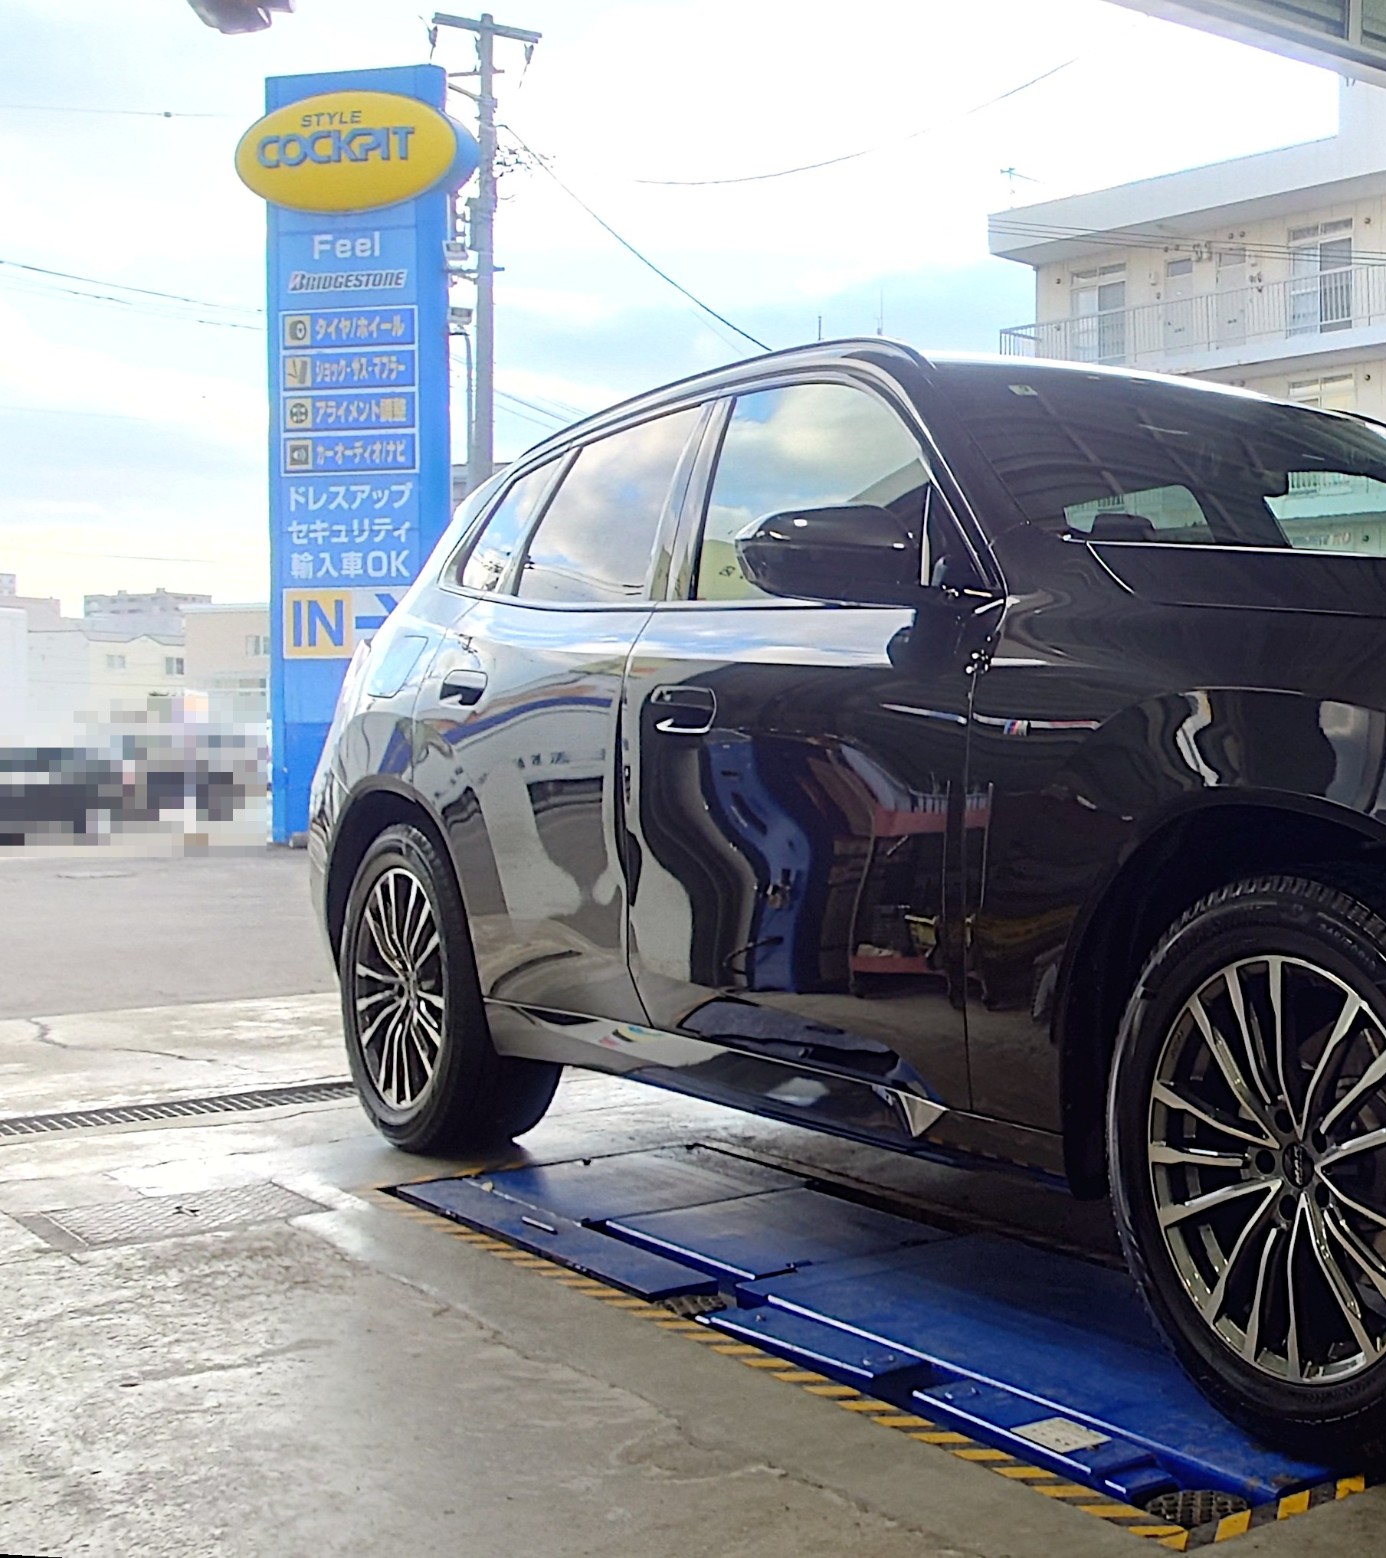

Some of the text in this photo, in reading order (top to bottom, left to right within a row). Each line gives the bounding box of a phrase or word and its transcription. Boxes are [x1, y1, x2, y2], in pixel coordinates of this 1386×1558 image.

[301, 110, 362, 127] STYLE
[257, 126, 415, 169] COCKPIT
[313, 231, 380, 260] Feel
[290, 271, 405, 292] BRIDGESTONE
[289, 481, 413, 512] ドレスアップ
[288, 518, 412, 545] セキュリティ
[290, 549, 411, 580] 輸入車OK
[293, 599, 344, 647] IN
